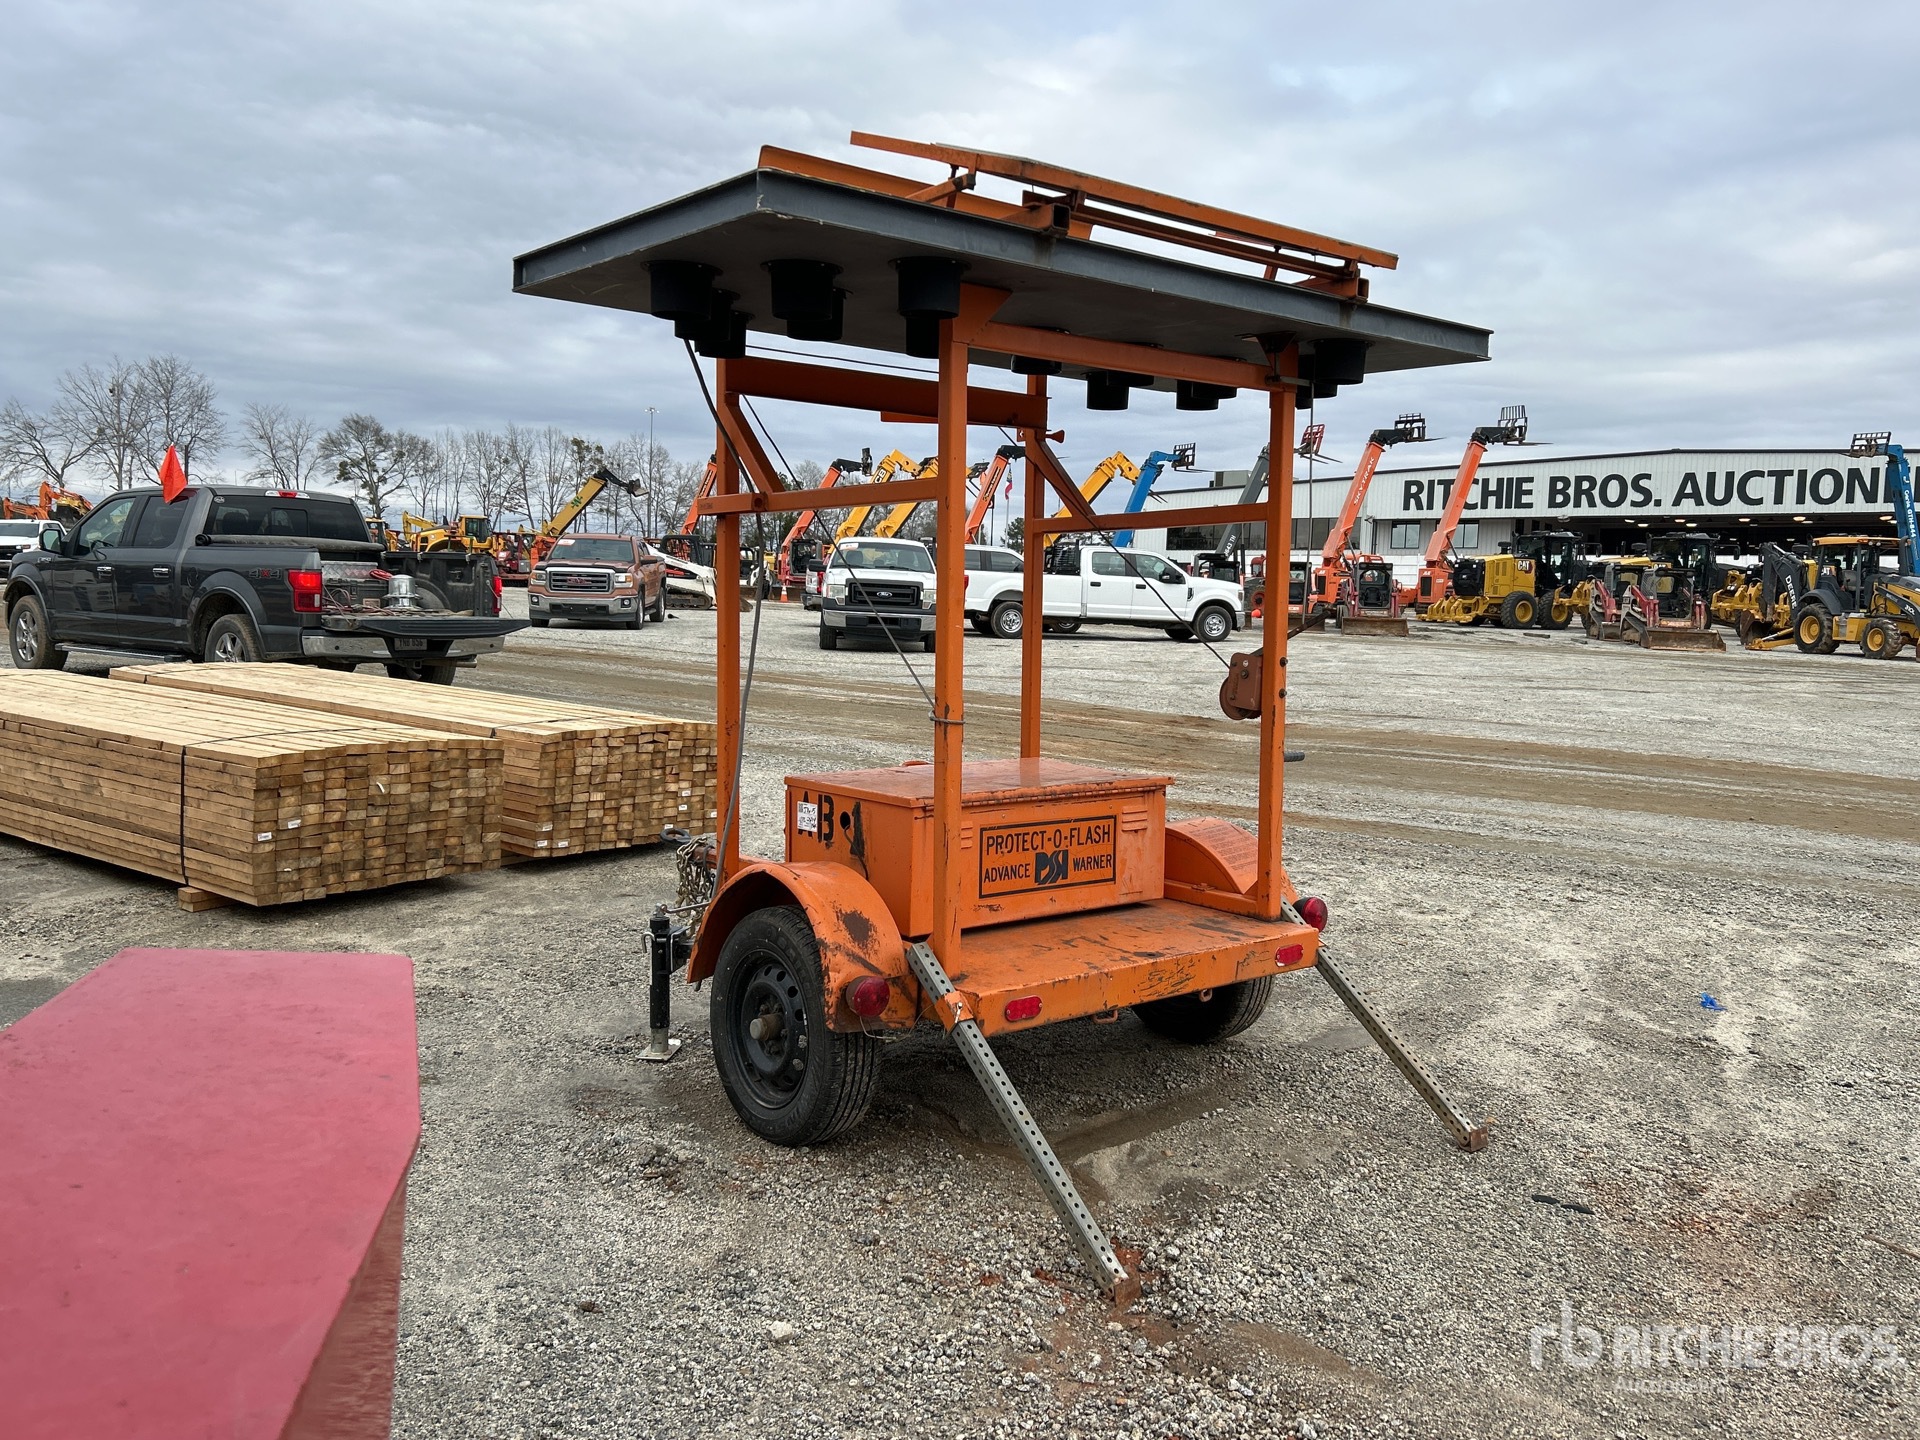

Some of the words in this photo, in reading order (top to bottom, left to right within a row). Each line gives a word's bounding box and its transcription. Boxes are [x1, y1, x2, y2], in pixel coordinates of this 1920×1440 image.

[874, 468, 887, 484] CB
[1353, 457, 1374, 505] SKYTRAK
[1403, 476, 1534, 511] RITCHIE
[1547, 472, 1662, 509] BROS.
[1672, 466, 1920, 508] AUCTION
[1517, 560, 1530, 571] CAT
[1785, 575, 1798, 610] DEERE
[986, 824, 1111, 856] PROTECT-O-FLASH
[983, 863, 1031, 884] ADVANCE
[1072, 854, 1113, 872] WARNER
